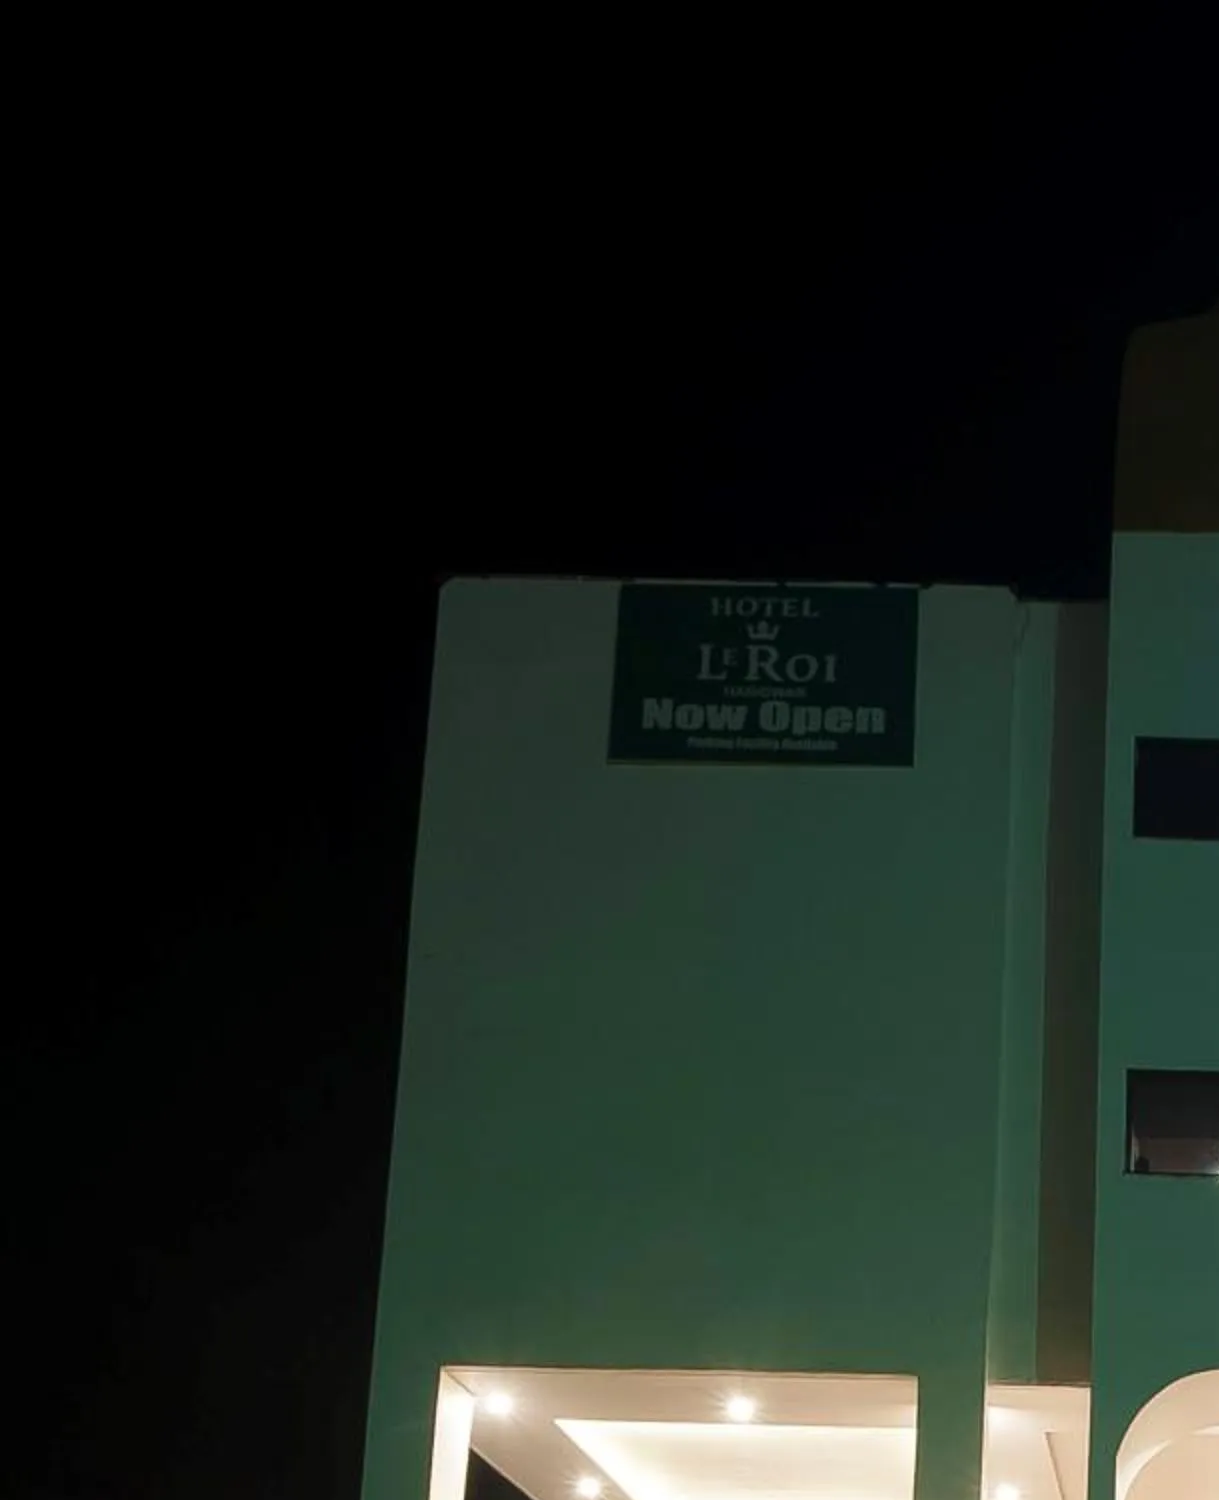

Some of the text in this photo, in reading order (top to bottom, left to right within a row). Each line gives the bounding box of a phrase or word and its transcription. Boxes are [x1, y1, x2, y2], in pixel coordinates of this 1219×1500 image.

[710, 596, 820, 618] HOTEL
[642, 697, 887, 736] Now Open
